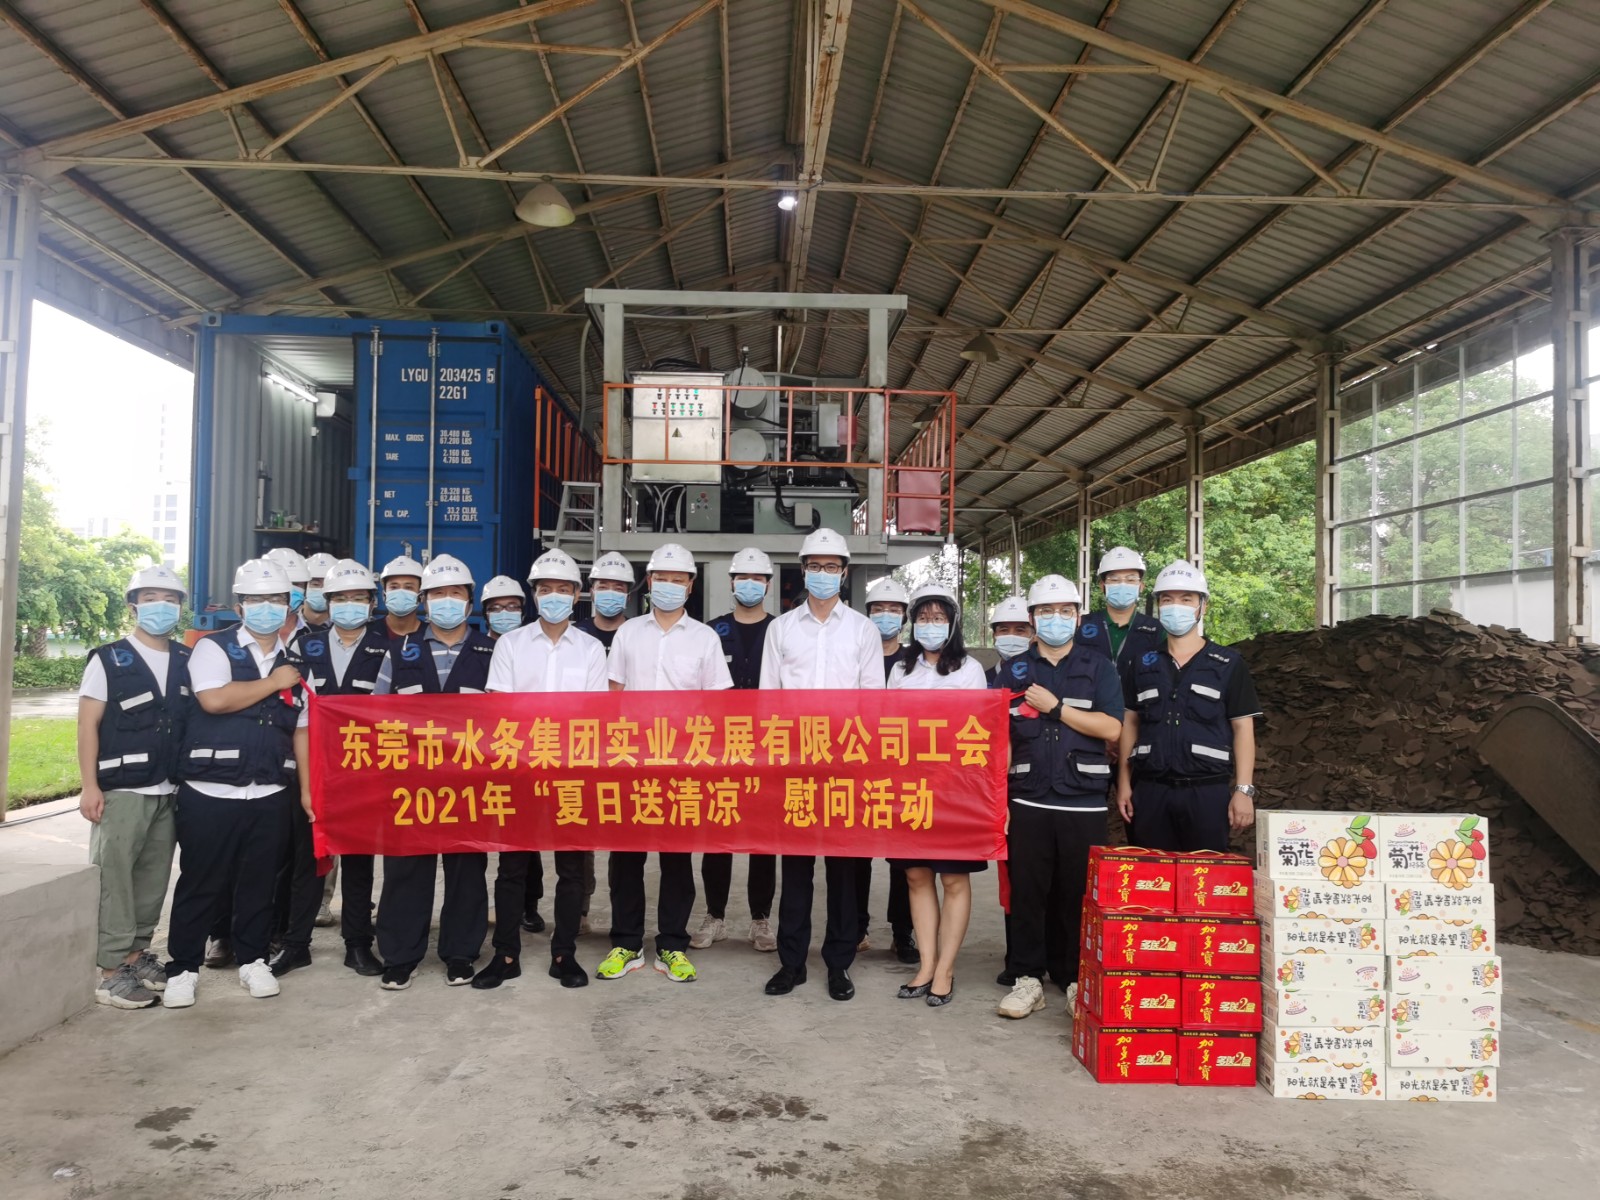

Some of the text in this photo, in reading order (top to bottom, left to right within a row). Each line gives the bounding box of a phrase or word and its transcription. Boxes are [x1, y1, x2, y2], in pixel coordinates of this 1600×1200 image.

[401, 368, 494, 383] LYGU 203425 5
[439, 386, 467, 399] 22G1
[385, 433, 424, 442] MAX. GROSS
[461, 437, 472, 445] LBS
[385, 453, 399, 461] TARE
[461, 449, 470, 457] KG
[384, 490, 396, 498] NET
[462, 487, 470, 495] KG
[397, 510, 410, 518] CAP.
[447, 506, 460, 514] 33.2
[340, 714, 992, 772] 东莞市水务集团实业发展有限公司工会
[1312, 892, 1373, 905] 阳光就是希望
[1424, 894, 1483, 907] 阳光就是希望
[1287, 931, 1346, 944] 阳光就是希望
[1398, 933, 1458, 946] 阳光就是希望
[1314, 1037, 1373, 1050] 阳光就是希望
[1286, 1075, 1348, 1090] 阳光就是希望
[1400, 1078, 1460, 1091] 阳光就是希望
